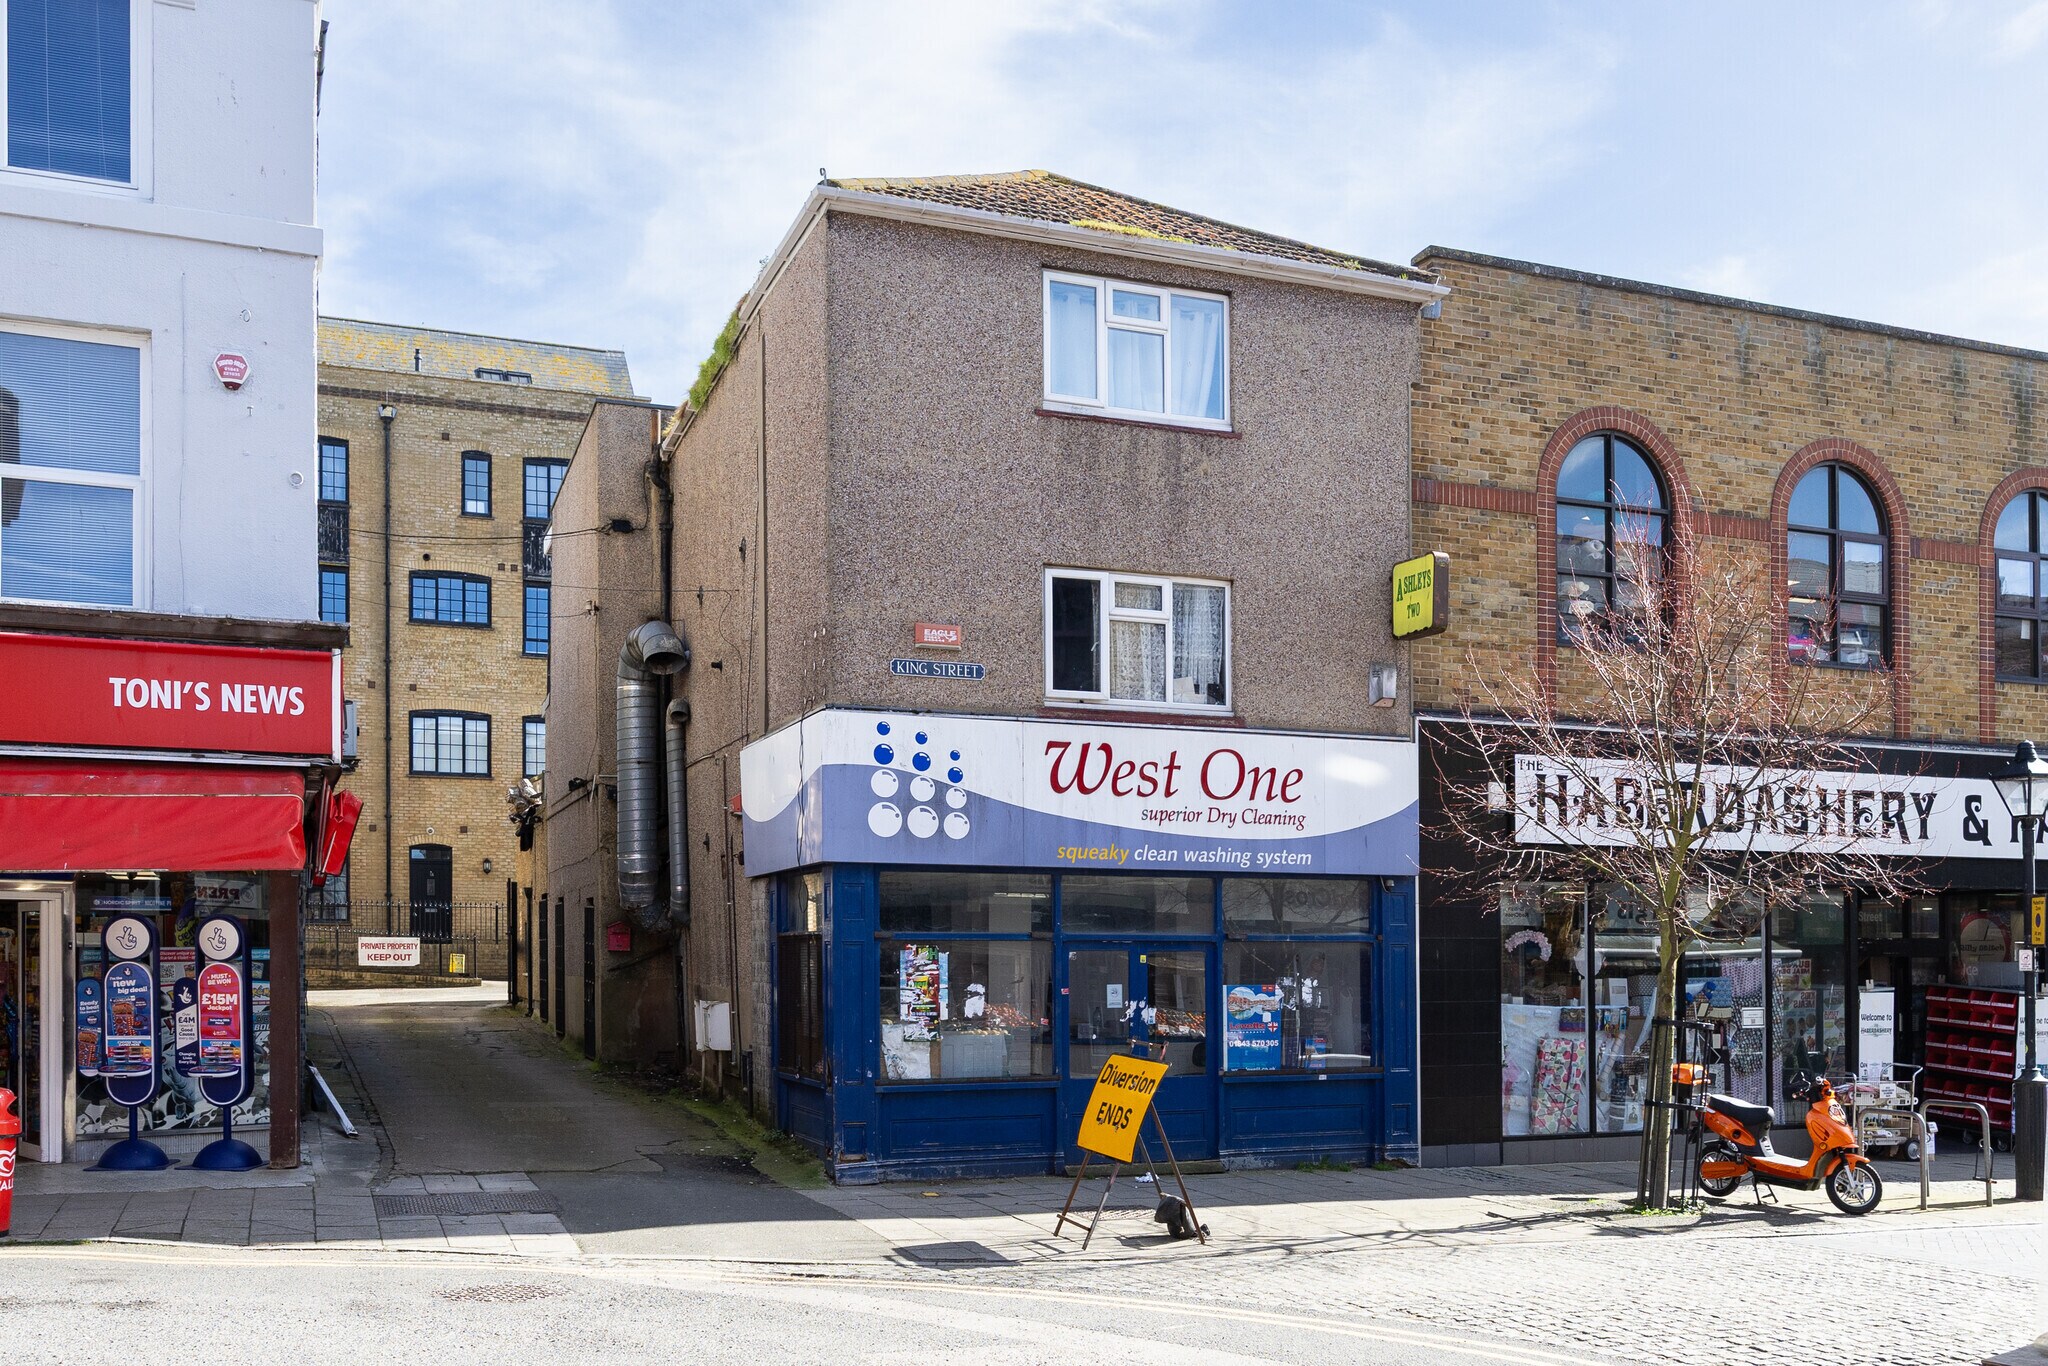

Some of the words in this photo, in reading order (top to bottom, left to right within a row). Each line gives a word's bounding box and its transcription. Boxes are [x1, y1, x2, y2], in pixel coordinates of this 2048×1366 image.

[1396, 569, 1432, 602] ASHLEYS
[1406, 602, 1421, 619] TWO
[923, 628, 957, 637] EAGLE
[896, 660, 928, 675] KING
[932, 663, 979, 677] STREET
[109, 677, 211, 711] TONI'S
[221, 683, 305, 716] NEWS
[1044, 740, 1181, 798] West
[1200, 748, 1304, 803] One
[1517, 758, 1545, 772] THE
[1141, 805, 1203, 826] superior
[1207, 807, 1237, 829] Dry
[1241, 808, 1306, 831] Cleaning
[1962, 794, 1993, 846] &
[1057, 843, 1129, 865] squeaky
[1134, 845, 1178, 862] clean
[1184, 846, 1252, 868] washing
[1256, 849, 1312, 869] system
[1858, 910, 1883, 922] Street
[360, 942, 386, 950] PRIVATE
[387, 942, 419, 950] PROPERTY
[367, 953, 392, 961] KEEP
[393, 953, 412, 961] OUT
[113, 979, 136, 988] new
[201, 993, 238, 1005] £15M
[178, 1016, 195, 1024] £4M
[1860, 1013, 1885, 1021] Welcome
[1886, 1013, 1893, 1021] to
[1229, 1040, 1251, 1048] 01843
[1099, 1063, 1156, 1095] Diversion
[1095, 1101, 1133, 1129] ENDS
